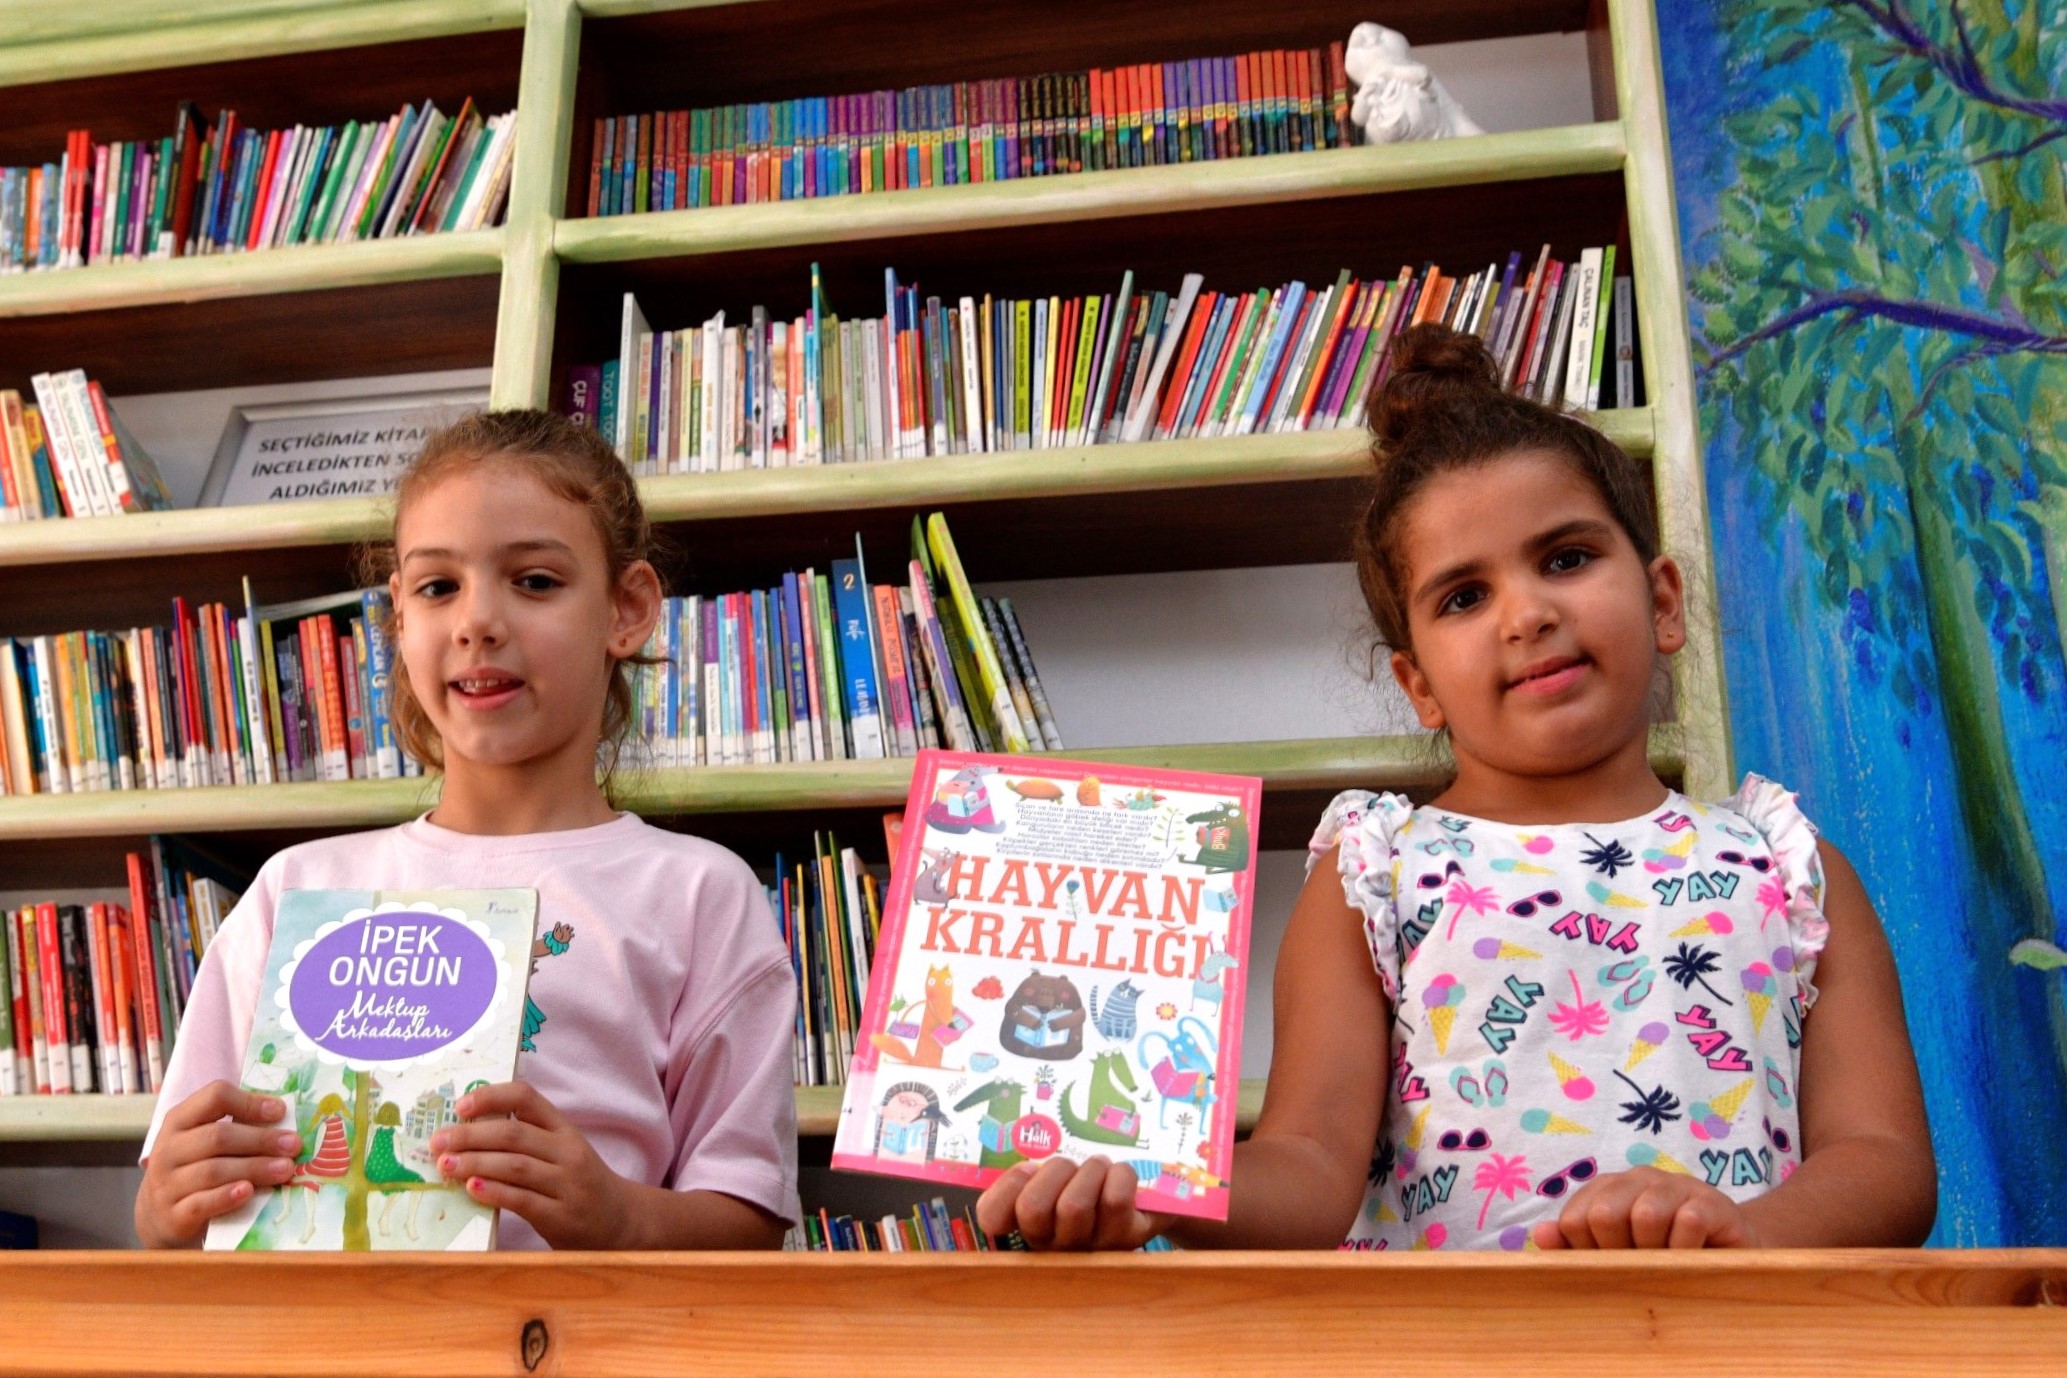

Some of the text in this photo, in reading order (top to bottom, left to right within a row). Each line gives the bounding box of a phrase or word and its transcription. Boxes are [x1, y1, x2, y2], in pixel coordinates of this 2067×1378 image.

[572, 380, 587, 408] ÇUF
[602, 371, 615, 407] TOOT
[259, 429, 371, 453] SEÇTİĞİMİZ
[251, 454, 391, 478] İNCELEDİKTEN
[269, 479, 376, 500] ALDIĞIMIZ
[843, 573, 857, 590] 2
[1211, 826, 1226, 850] Book
[946, 854, 1206, 925] HAYVAN
[1652, 870, 1740, 906] YAY
[360, 919, 443, 954] İPEK
[920, 906, 1212, 980] KRALLIĞI
[1548, 910, 1641, 955] YAY
[329, 956, 462, 986] ONGUN
[314, 1009, 453, 1041] Arkadaşları
[342, 990, 430, 1026] Mektup
[1478, 974, 1545, 1055] YAY
[1675, 1004, 1753, 1072] YAY
[1700, 1147, 1774, 1187] YAY
[1401, 1164, 1459, 1222] YAY
